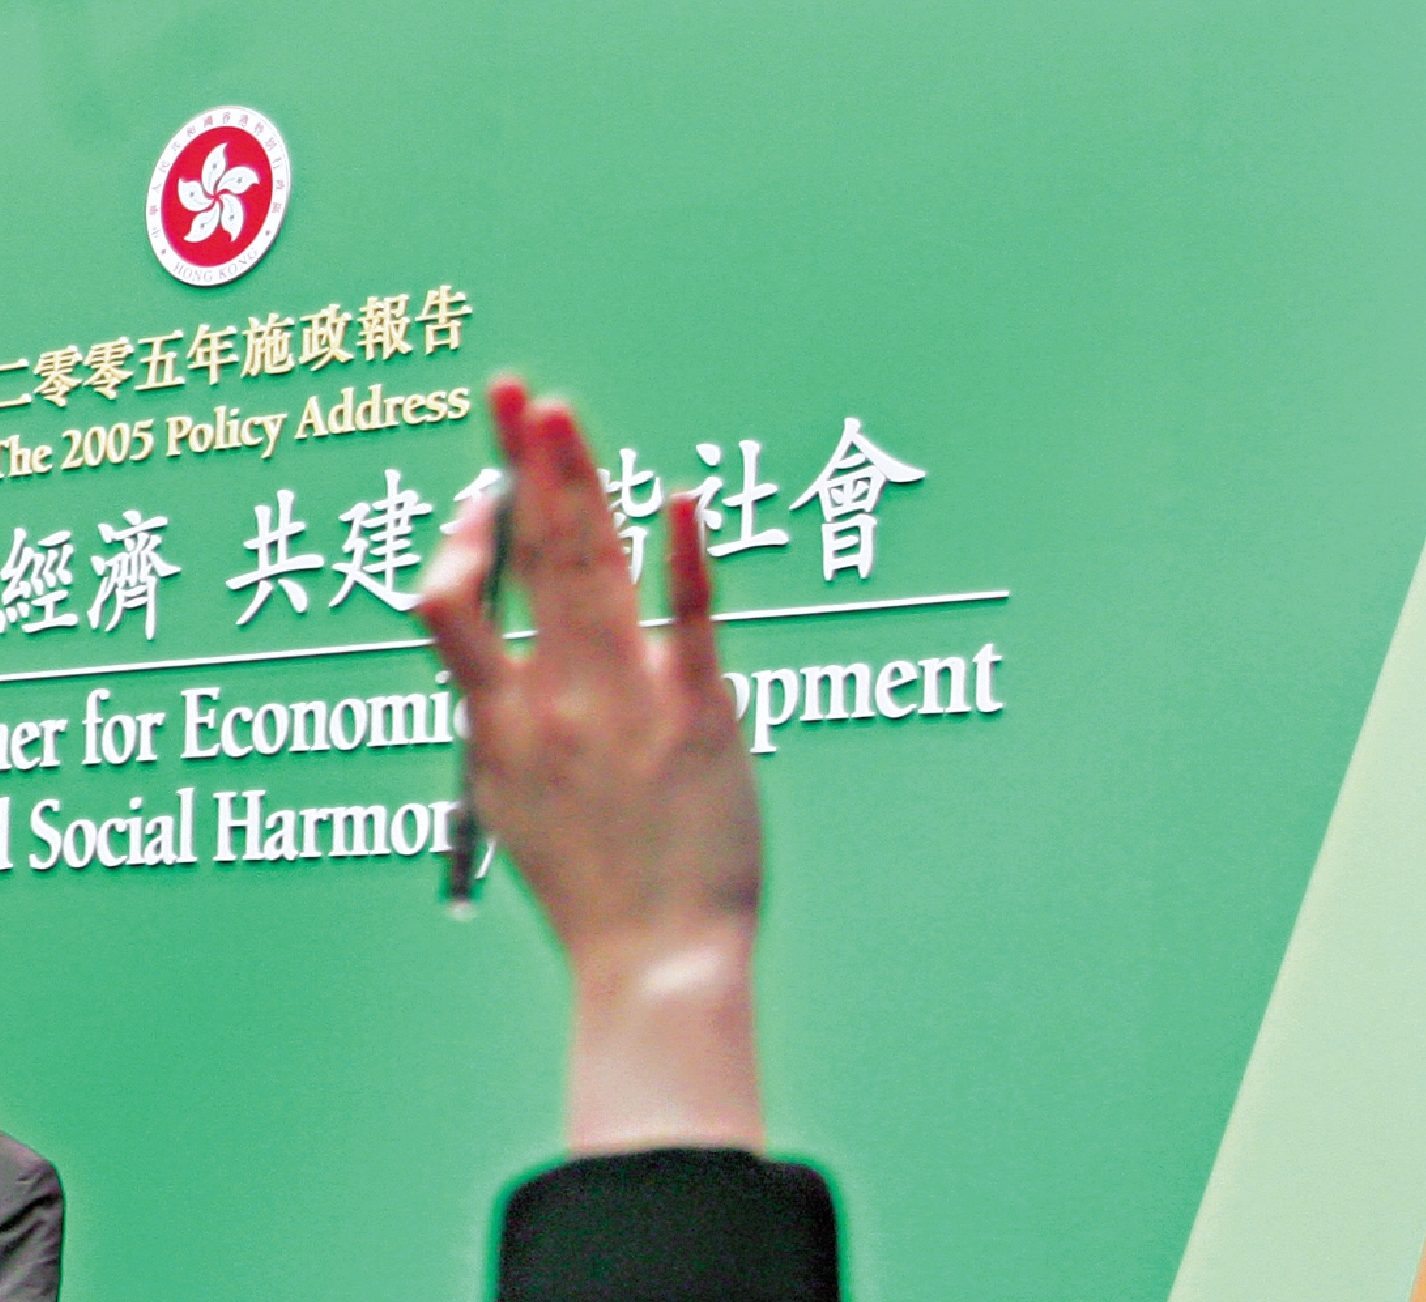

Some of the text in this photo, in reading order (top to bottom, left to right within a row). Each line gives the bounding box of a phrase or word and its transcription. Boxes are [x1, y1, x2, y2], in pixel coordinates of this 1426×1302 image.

[61, 417, 154, 470] 2005
[165, 405, 288, 459] Policy
[294, 383, 471, 440] Address
[225, 416, 927, 625] 共建社會
[81, 688, 166, 766] for
[28, 787, 198, 870] Social
